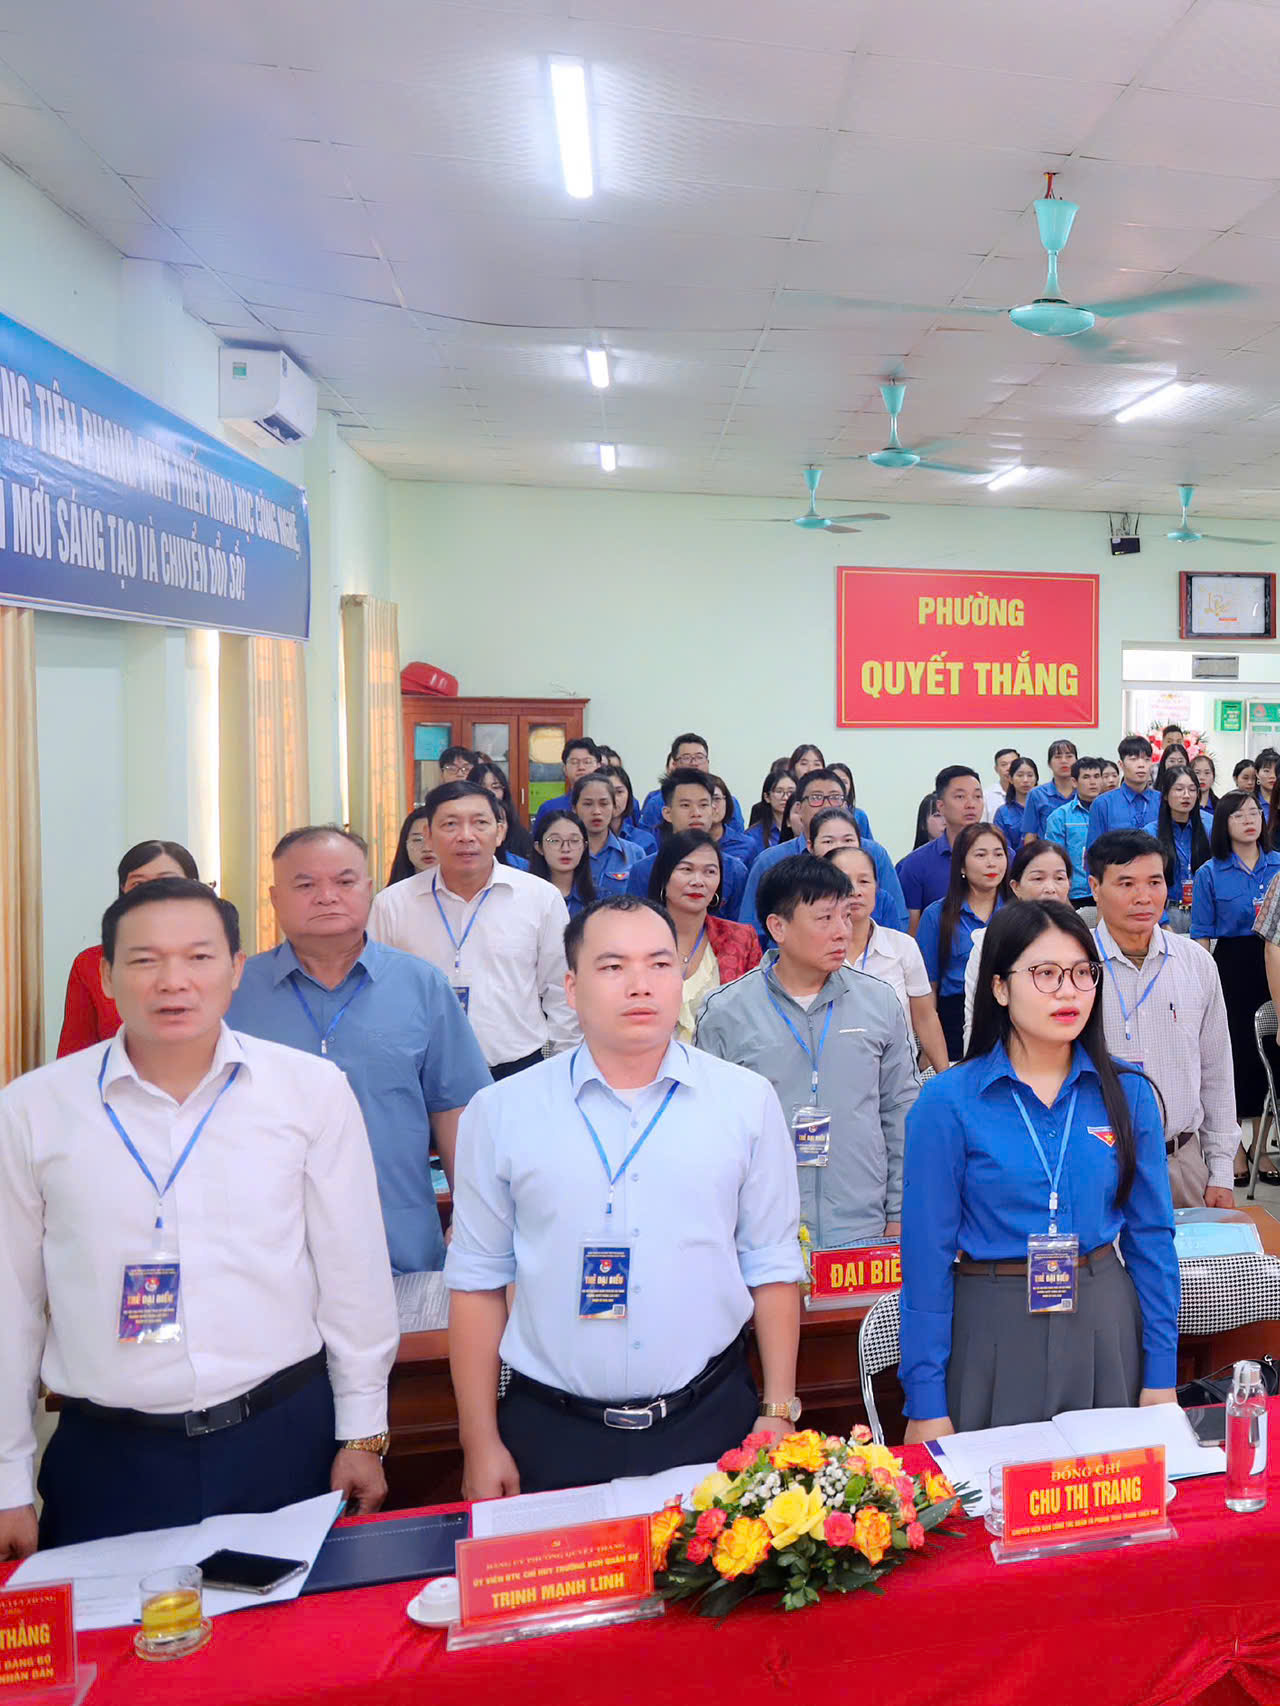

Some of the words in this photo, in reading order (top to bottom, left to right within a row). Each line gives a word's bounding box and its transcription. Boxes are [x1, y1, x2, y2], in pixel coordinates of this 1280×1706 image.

[0, 364, 33, 447] NG
[34, 377, 80, 465] TIÊN
[81, 407, 137, 489] PHONG
[207, 470, 236, 527] KHOA
[234, 483, 254, 543] HỌC
[255, 488, 280, 544] CÔNG
[12, 474, 52, 559] MỚI
[57, 487, 104, 571] SÁNG
[107, 511, 137, 589] TẠO
[139, 513, 159, 583] VÀ
[161, 520, 208, 593] CHUYỂN
[208, 530, 228, 597] ĐỔI
[918, 591, 1025, 626] PHƯỜNG
[861, 651, 964, 698] QUYẾT
[973, 650, 1078, 696] THẮNG
[831, 1261, 865, 1292] ĐẠI
[1095, 1460, 1121, 1477] CHÍ
[1029, 1487, 1061, 1516] CHU
[1065, 1483, 1089, 1514] THỊ
[1093, 1476, 1142, 1508] TRANG
[491, 1587, 537, 1609] TRỊNH
[541, 1580, 587, 1601] MẠNH
[590, 1572, 625, 1593] LINH
